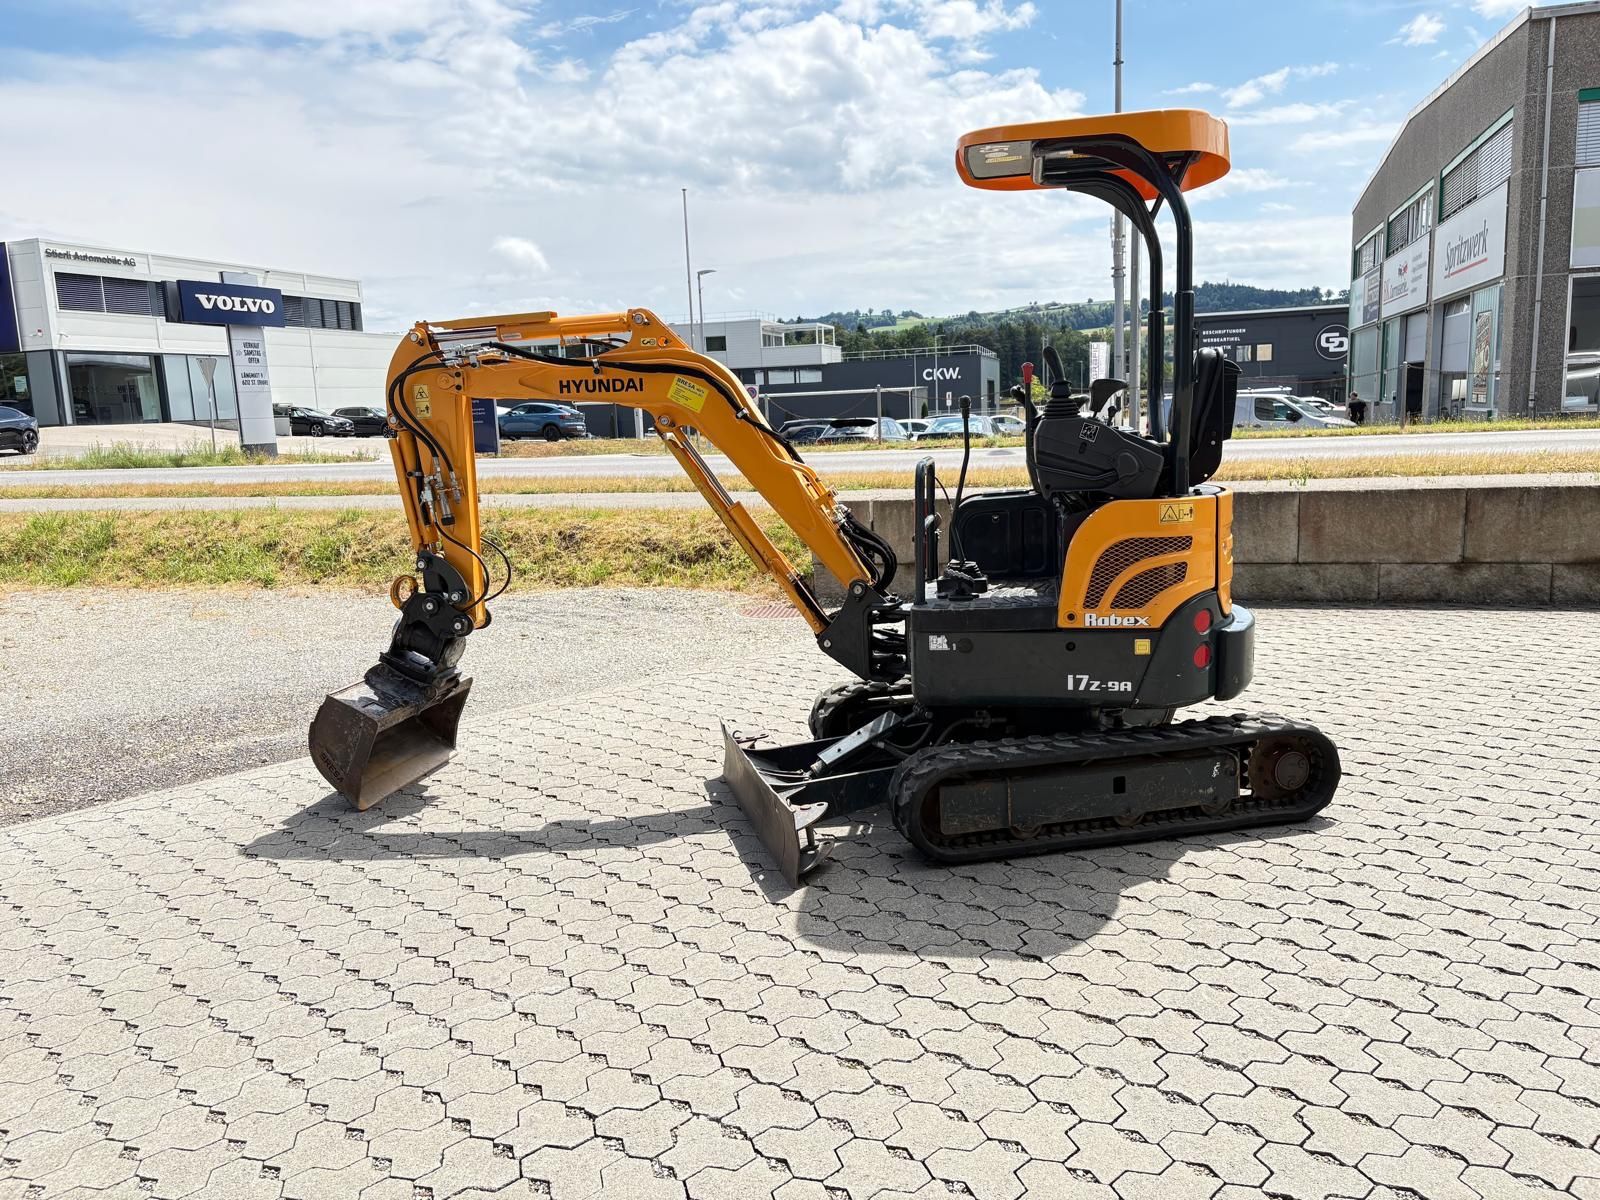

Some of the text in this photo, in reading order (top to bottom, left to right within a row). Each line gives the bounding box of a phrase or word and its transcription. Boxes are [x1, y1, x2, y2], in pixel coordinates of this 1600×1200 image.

[1444, 219, 1488, 273] Spritzwerk
[45, 248, 71, 260] Stierli
[121, 257, 136, 267] AG
[195, 293, 275, 314] VOLVO
[922, 366, 962, 381] CKW.
[559, 377, 644, 394] HYUNDAI
[1084, 613, 1151, 627] Robex
